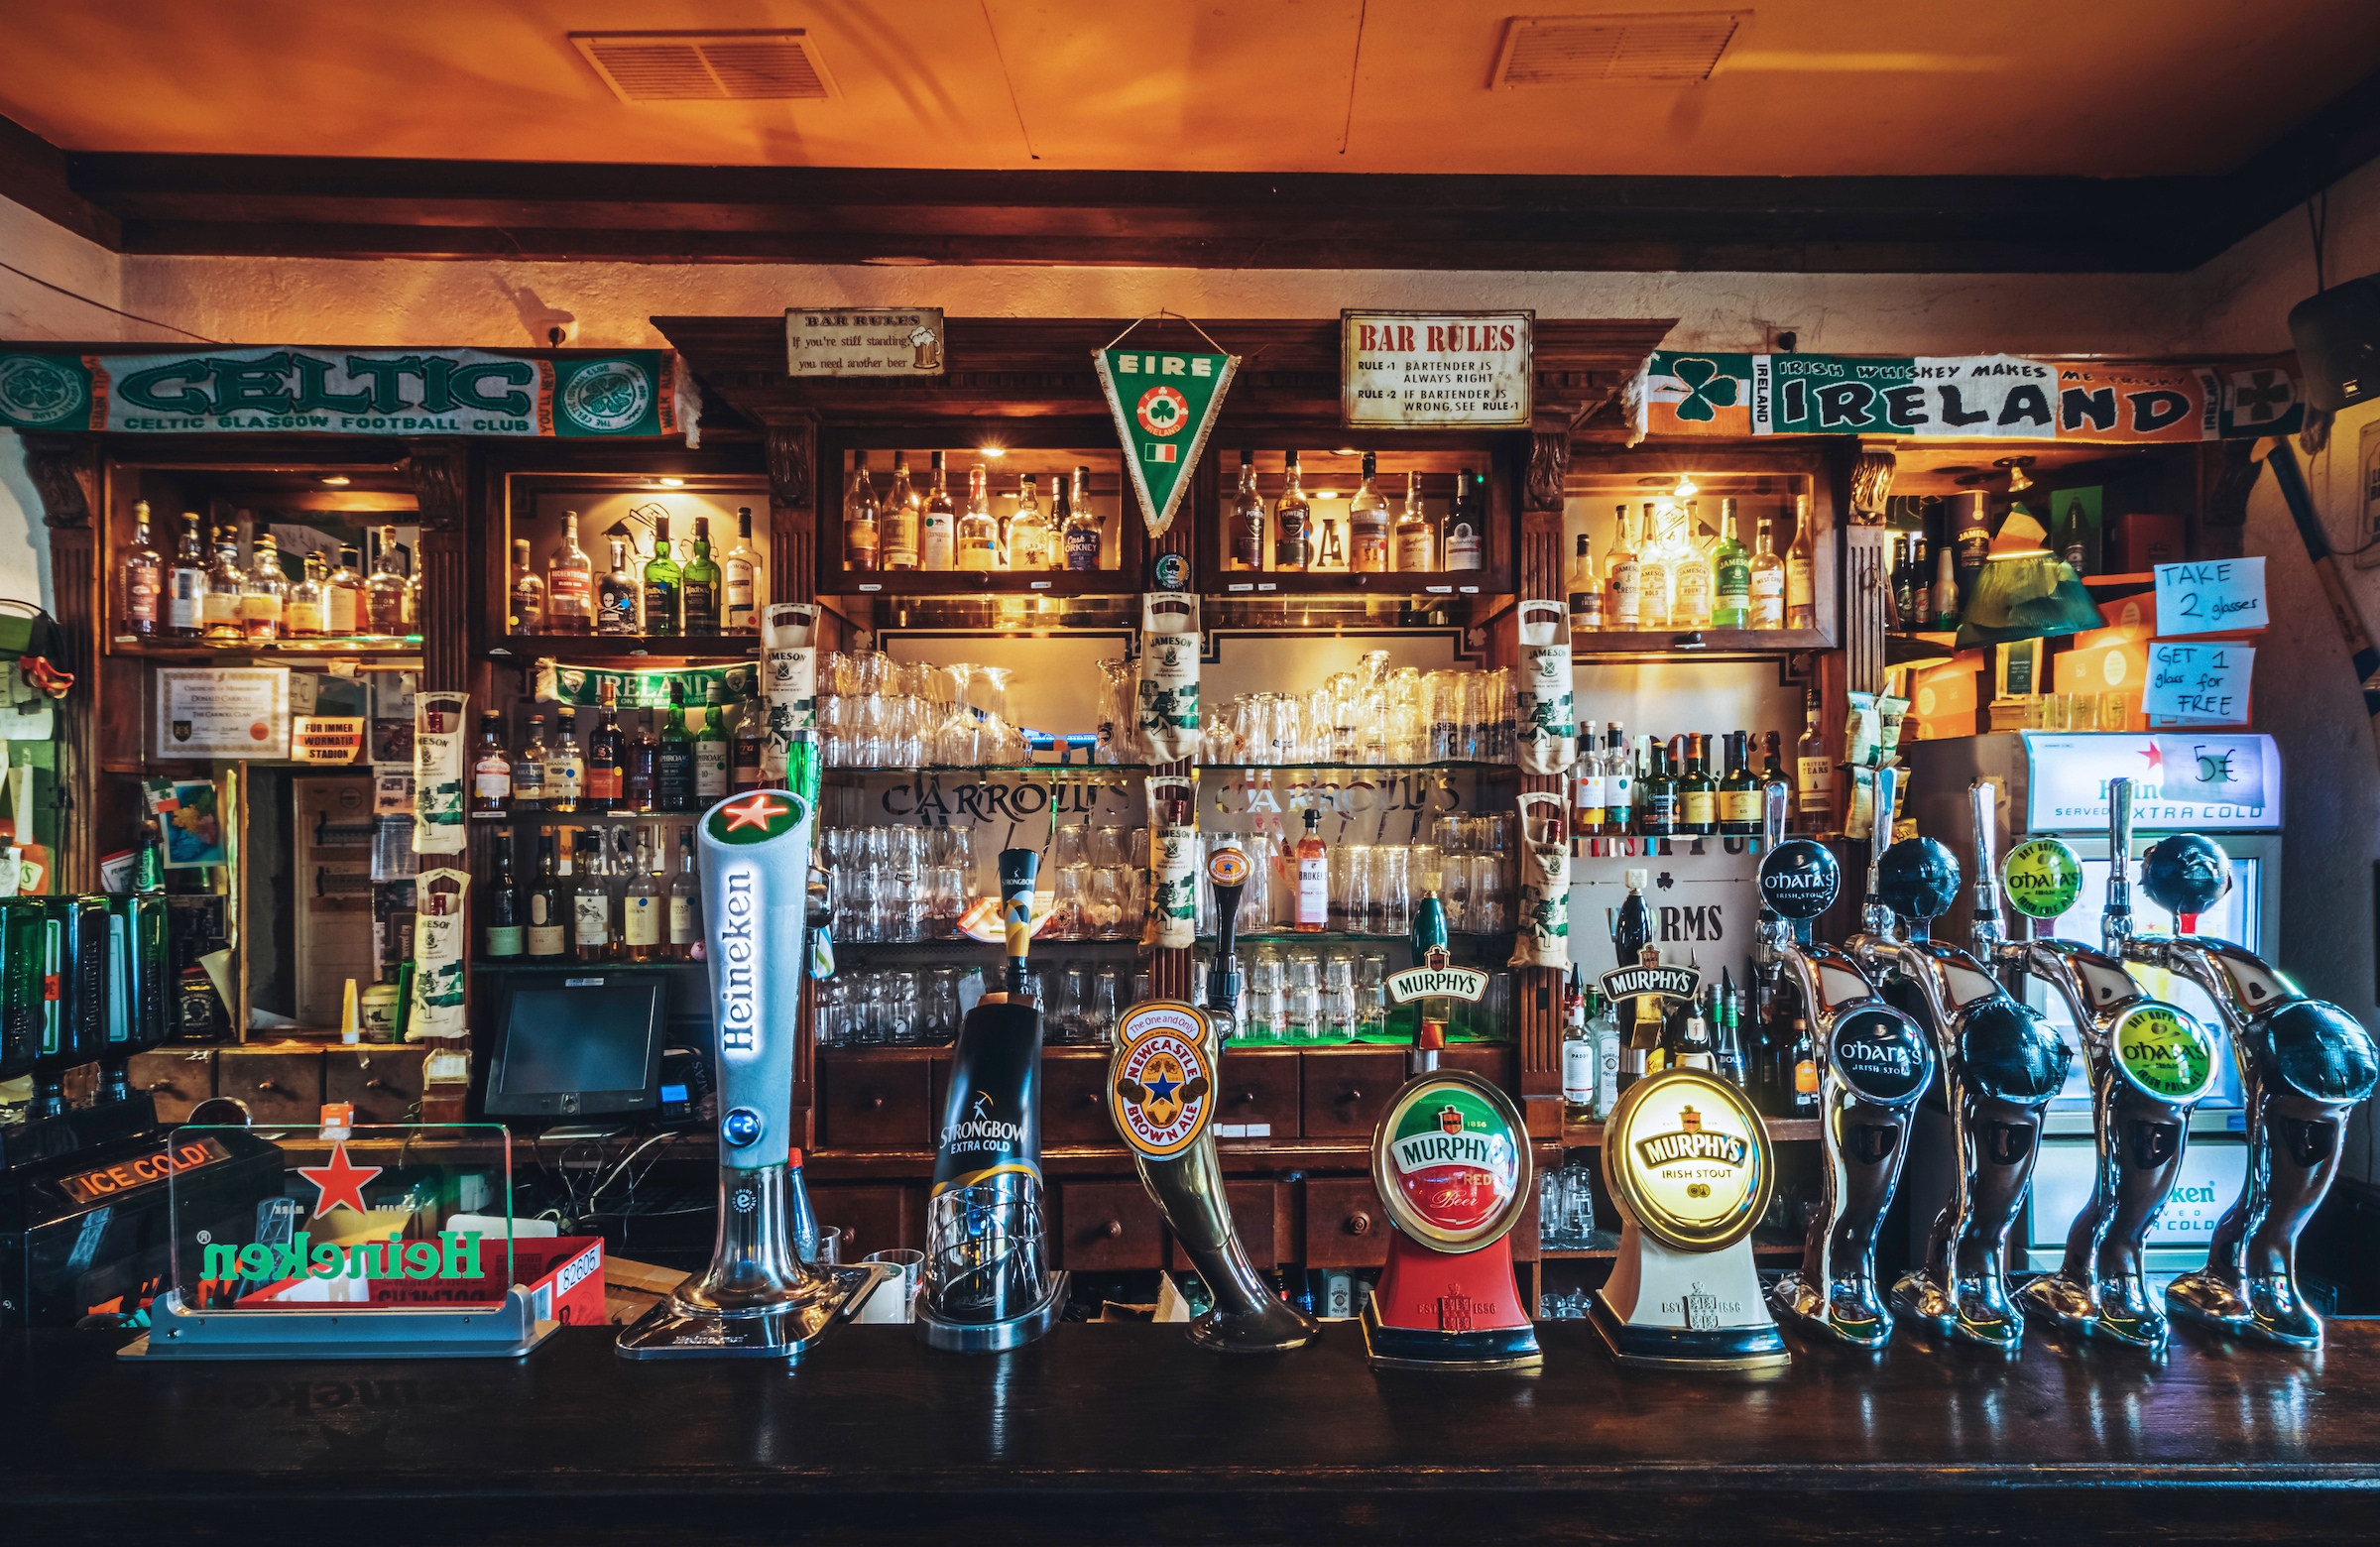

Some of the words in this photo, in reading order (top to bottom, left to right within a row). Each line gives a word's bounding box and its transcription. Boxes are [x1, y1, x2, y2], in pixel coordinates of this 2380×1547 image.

[805, 315, 849, 327] BAR
[854, 315, 920, 327] RULES
[792, 337, 800, 349] If
[805, 336, 836, 349] you're
[841, 335, 861, 346] still
[1359, 324, 1415, 352] BAR
[1427, 324, 1515, 352] RULES
[798, 360, 816, 371] you
[821, 357, 842, 368] need
[848, 357, 883, 368] another
[888, 357, 907, 368] beer
[1119, 354, 1212, 377] EIRE
[1359, 362, 1383, 371] RULE
[1406, 362, 1475, 371] BARTENDER
[1481, 362, 1491, 371] IS
[1780, 361, 1844, 376] IRISH
[1856, 364, 1961, 380] WHISKEY
[1971, 362, 2047, 378] MAKES
[2061, 371, 2093, 383] ME
[118, 352, 534, 417] CELTIC
[1404, 374, 1451, 383] ALWAYS
[1457, 374, 1493, 383] RIGHT
[1404, 390, 1415, 399] IF
[1421, 390, 1489, 399] BARTENDER
[1495, 390, 1506, 399] IS
[1756, 363, 1768, 423] IRELAND
[1404, 402, 1452, 413] WRONG,
[1456, 402, 1476, 411] SEE
[1483, 402, 1508, 411] RULE
[1783, 378, 2191, 433] IRELAND
[2202, 374, 2220, 431] IRELAND
[124, 417, 205, 429] CELTIC
[218, 416, 328, 428] GLASGOW
[341, 417, 460, 431] FOOTBALL
[473, 417, 530, 431] CLUB
[1145, 423, 1181, 437] IRELAND
[1067, 536, 1085, 544] Cask
[2162, 563, 2231, 586] TAKE
[2180, 593, 2203, 617] 2
[2212, 596, 2259, 620] glasses
[1150, 637, 1193, 648] JAMESON
[2157, 647, 2198, 664] GET
[2212, 651, 2230, 669] 1
[2155, 666, 2185, 688] glass
[2197, 672, 2224, 692] for
[191, 694, 220, 703] DONALD
[221, 694, 251, 703] CARROLL
[2178, 695, 2232, 716] FREE
[305, 722, 322, 733] FÜR
[325, 723, 353, 733] IMMER
[304, 736, 353, 746] WORMATIA
[309, 749, 348, 759] STADION
[2195, 745, 2239, 782] 5€
[2055, 806, 2109, 816] SERVED
[2132, 806, 2194, 819] XTRA
[2203, 806, 2262, 819] COLD
[722, 870, 754, 1053] Heineken
[1398, 971, 1478, 997] MURPHY'S
[1610, 970, 1691, 994] MURPHY'S
[1130, 1021, 1145, 1034] The
[1144, 1015, 1161, 1026] One
[1162, 1014, 1178, 1023] and
[1178, 1018, 1197, 1034] Only
[2128, 1013, 2146, 1029] DRY
[1128, 1039, 1198, 1079] NEWCASTLE
[1852, 1064, 1880, 1073] IRISH
[2136, 1069, 2162, 1089] IRISH
[734, 1116, 754, 1132] -2
[1128, 1106, 1179, 1142] BROWN
[1178, 1105, 1198, 1132] ALE
[939, 1119, 1028, 1150] STRONGBOW
[950, 1139, 981, 1155] EXTRA
[982, 1139, 1011, 1153] COLD
[1645, 1132, 1742, 1165] MURPHY'S
[79, 1165, 136, 1196] ICE
[134, 1142, 214, 1180] COLD!
[1662, 1169, 1692, 1179] IRISH
[1697, 1168, 1732, 1178] STOUT
[1463, 1173, 1493, 1187] RED
[1430, 1190, 1480, 1209] Beer
[2167, 1220, 2214, 1231] COLD
[563, 1248, 597, 1291] 82605
[1662, 1302, 1685, 1313] EST.
[1718, 1302, 1742, 1313] 1856
